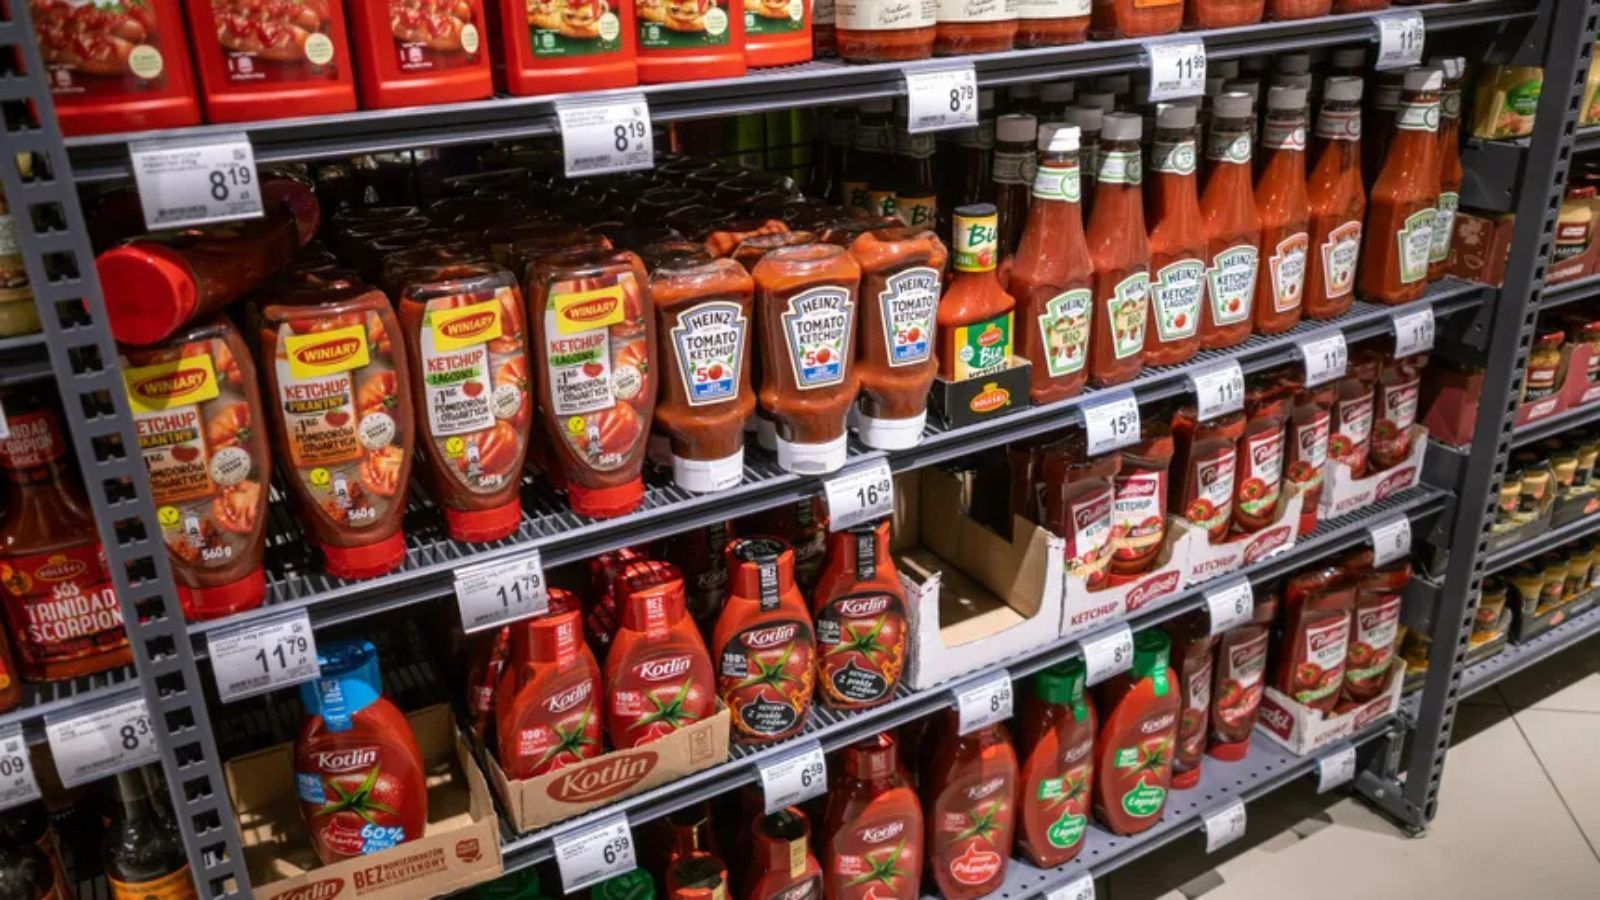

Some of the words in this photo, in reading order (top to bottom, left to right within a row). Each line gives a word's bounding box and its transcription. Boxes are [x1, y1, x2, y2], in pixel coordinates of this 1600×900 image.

[898, 278, 931, 293] HEINZ
[1167, 268, 1198, 284] HEINZ
[570, 301, 615, 318] WINIARY
[801, 297, 840, 314] HEINZ
[891, 295, 933, 314] TOMATO
[691, 312, 731, 329] HEINZ
[796, 314, 845, 335] TOMATO
[894, 308, 931, 323] KETCHUP
[447, 316, 493, 335] WINIARY
[551, 334, 605, 353] KETCHUP
[686, 330, 737, 350] TOMATO
[800, 329, 842, 345] KETCHUP
[1062, 329, 1081, 345] BIO
[303, 341, 358, 363] WINIARY
[427, 349, 484, 373] KETCHUP
[689, 344, 736, 360] KETCHUP
[144, 371, 205, 394] WINIARY
[284, 378, 349, 399] KETCHUP
[135, 412, 197, 435] ETCHUP
[202, 547, 223, 561] 560
[24, 588, 117, 625] TRINIDAD
[840, 598, 888, 614] Kotlin
[1071, 601, 1119, 626] KETCHUP
[29, 606, 124, 644] SCORPION
[746, 625, 796, 645] Kotlin
[640, 657, 691, 678] Kotlin
[550, 679, 593, 710] Kotlin
[318, 749, 377, 768] Kotlin
[561, 752, 648, 797] Kotlin
[361, 822, 405, 841] 60%
[862, 821, 904, 842] Kotlin
[353, 865, 385, 890] BEZ
